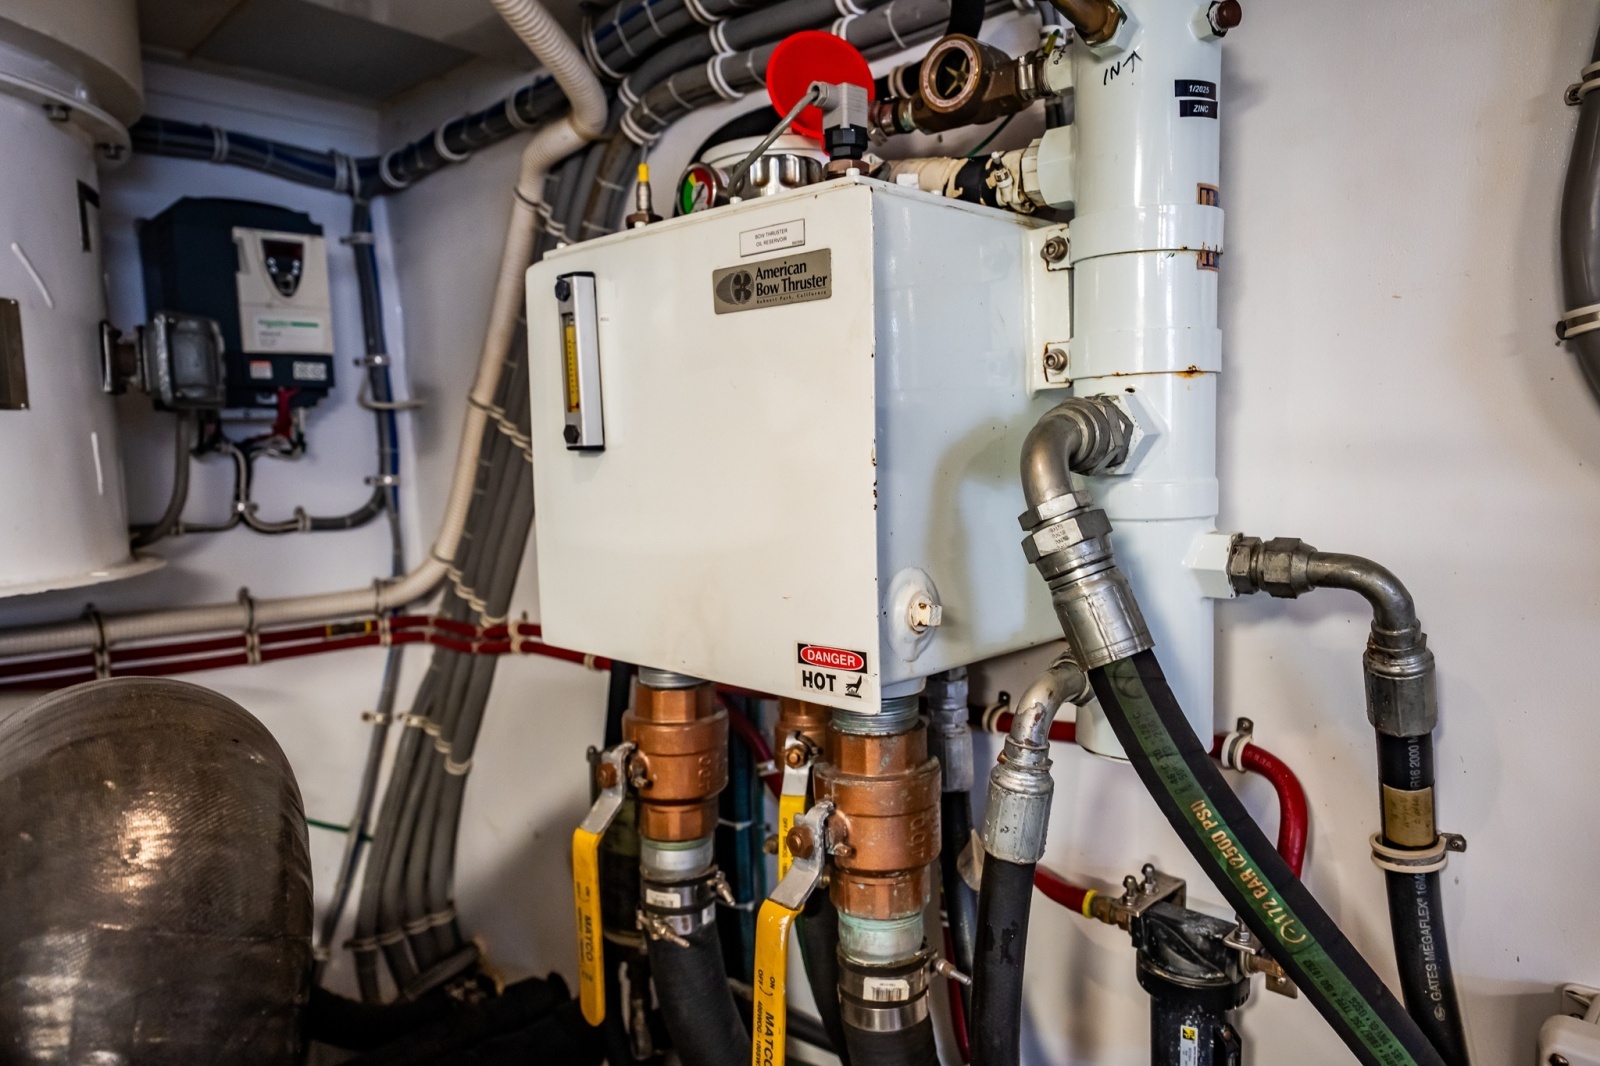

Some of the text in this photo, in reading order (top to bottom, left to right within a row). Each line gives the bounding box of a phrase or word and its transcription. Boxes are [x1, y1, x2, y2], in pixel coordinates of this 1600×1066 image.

[1103, 61, 1120, 86] IN
[1189, 85, 1210, 94] 1/2025
[1192, 104, 1209, 113] ZINC
[763, 236, 788, 245] RESERVOIR
[766, 228, 788, 237] THRUSTER
[755, 261, 807, 281] American
[756, 275, 828, 297] Bow Thruster
[796, 290, 827, 299] California
[807, 649, 856, 667] DANGER
[801, 669, 837, 692] HOT
[1408, 744, 1420, 768] 2000
[1190, 799, 1287, 924] 172 BAR (2500 PSI)
[584, 915, 593, 962] MATCO
[1416, 897, 1435, 962] MEGAFLEX®
[769, 976, 776, 990] ON
[1320, 979, 1334, 993] ISO
[1426, 962, 1442, 1001] GATES
